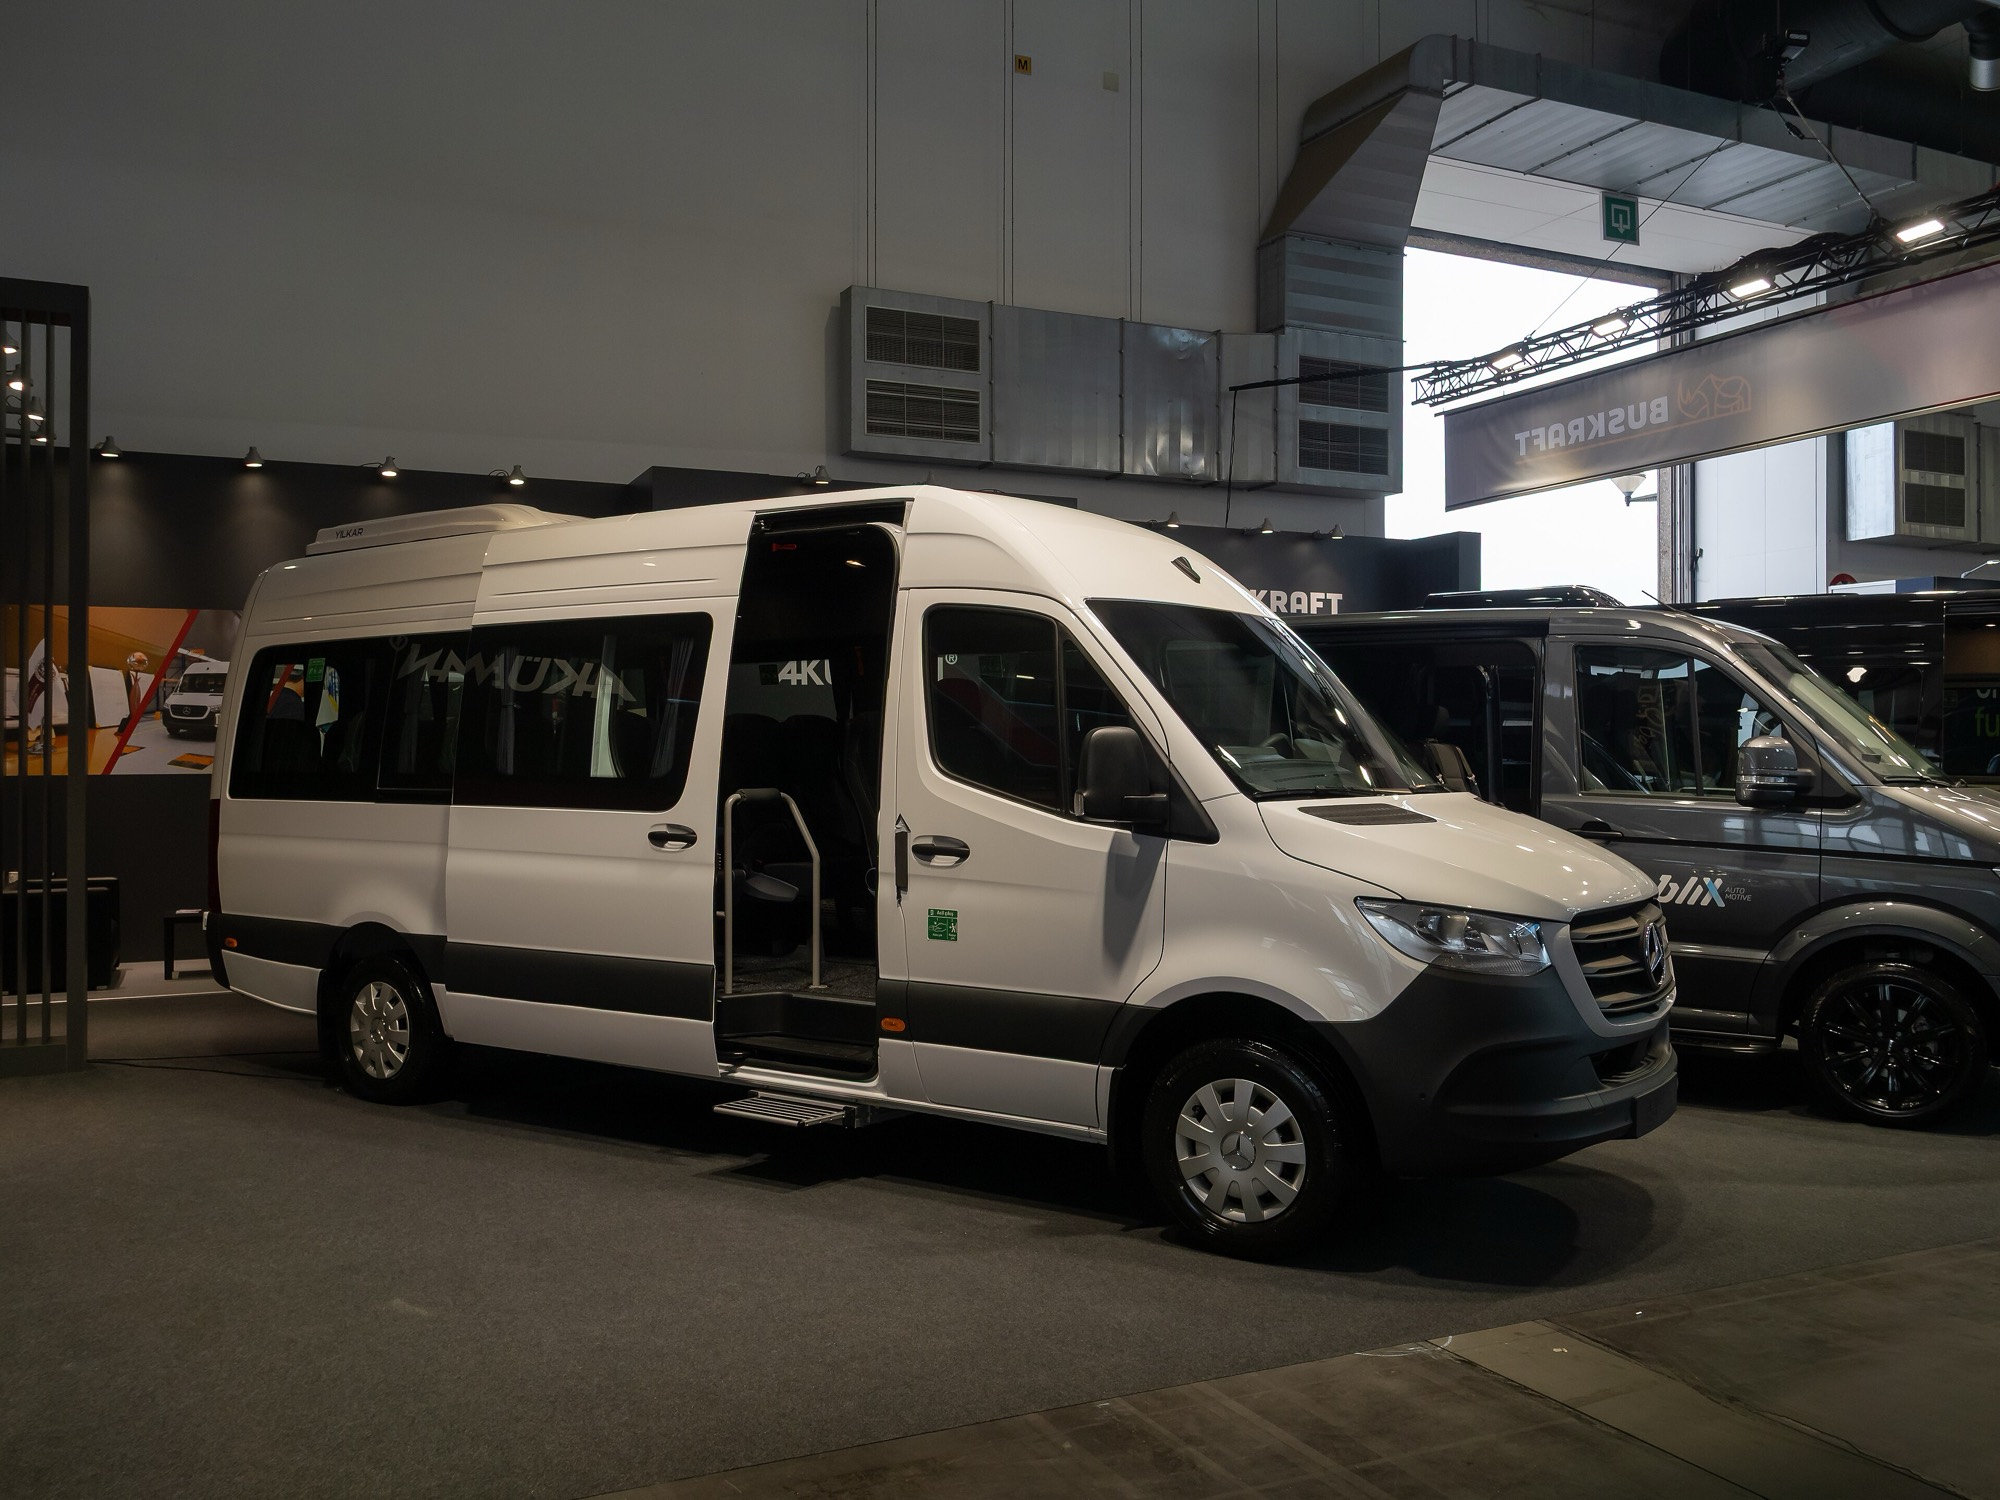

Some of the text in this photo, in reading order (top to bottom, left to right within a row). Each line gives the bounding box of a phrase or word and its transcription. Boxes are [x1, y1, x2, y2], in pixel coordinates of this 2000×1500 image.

[1018, 59, 1028, 71] M
[336, 528, 364, 539] YILKAR
[1725, 887, 1745, 895] AUTO
[1725, 893, 1752, 902] MOTIVE
